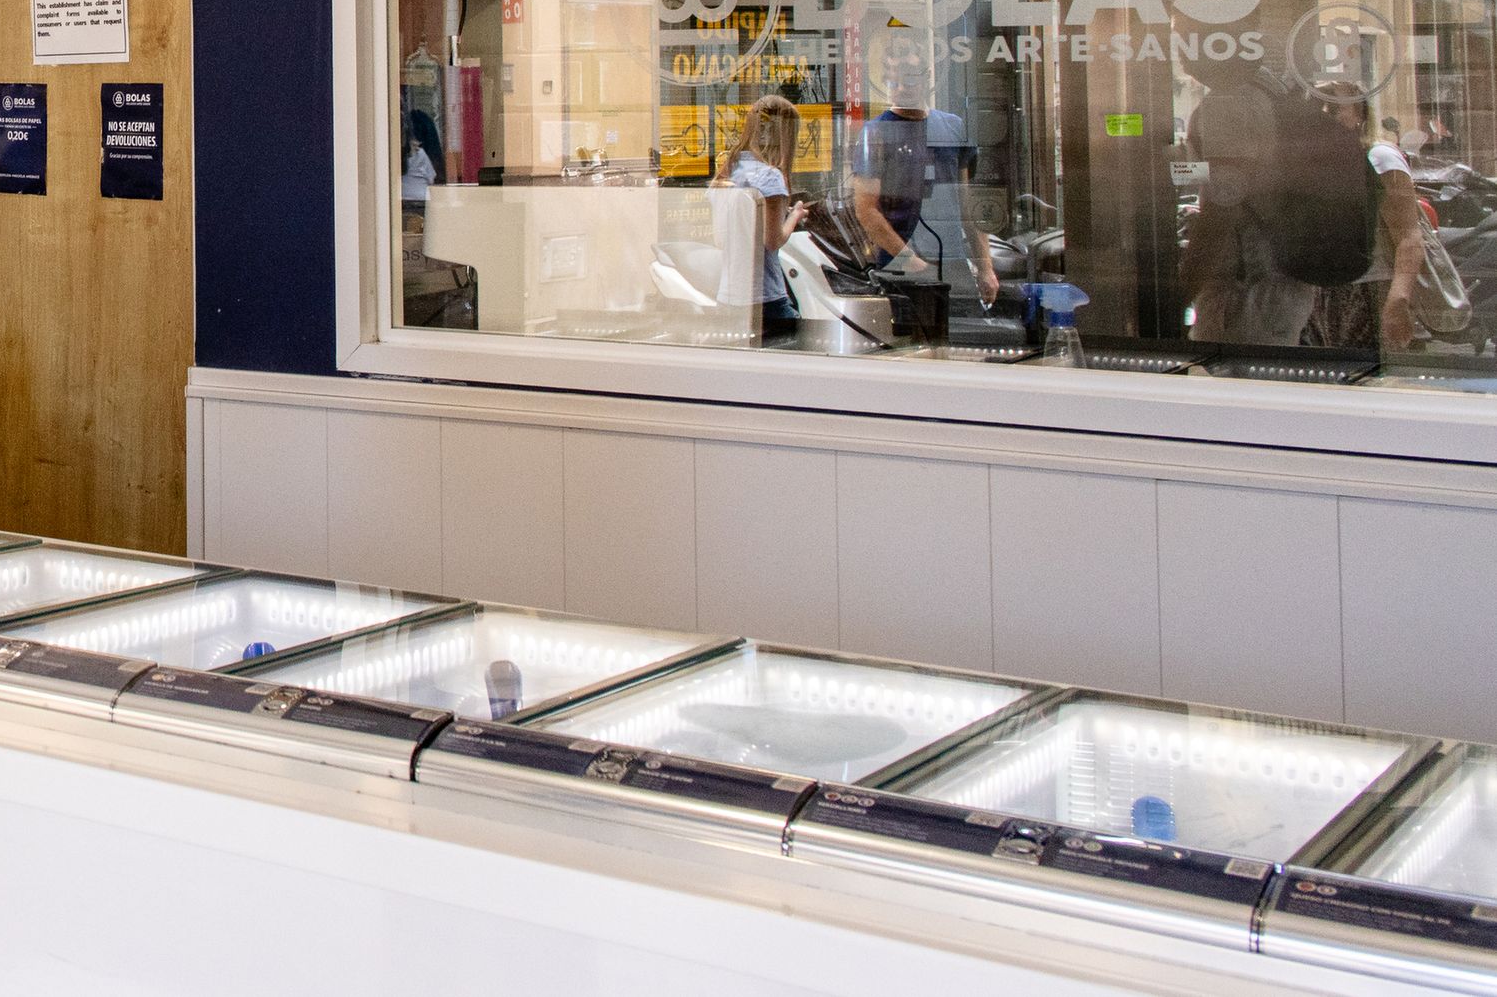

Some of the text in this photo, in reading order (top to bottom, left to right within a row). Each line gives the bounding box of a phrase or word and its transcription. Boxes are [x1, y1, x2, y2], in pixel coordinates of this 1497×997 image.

[14, 98, 35, 106] BOLAS
[126, 94, 151, 102] BOLAS
[108, 121, 155, 132] NO SE ACEPTAN
[7, 130, 29, 141] 0,20€
[106, 135, 158, 147] DEVOLUCIONES.
